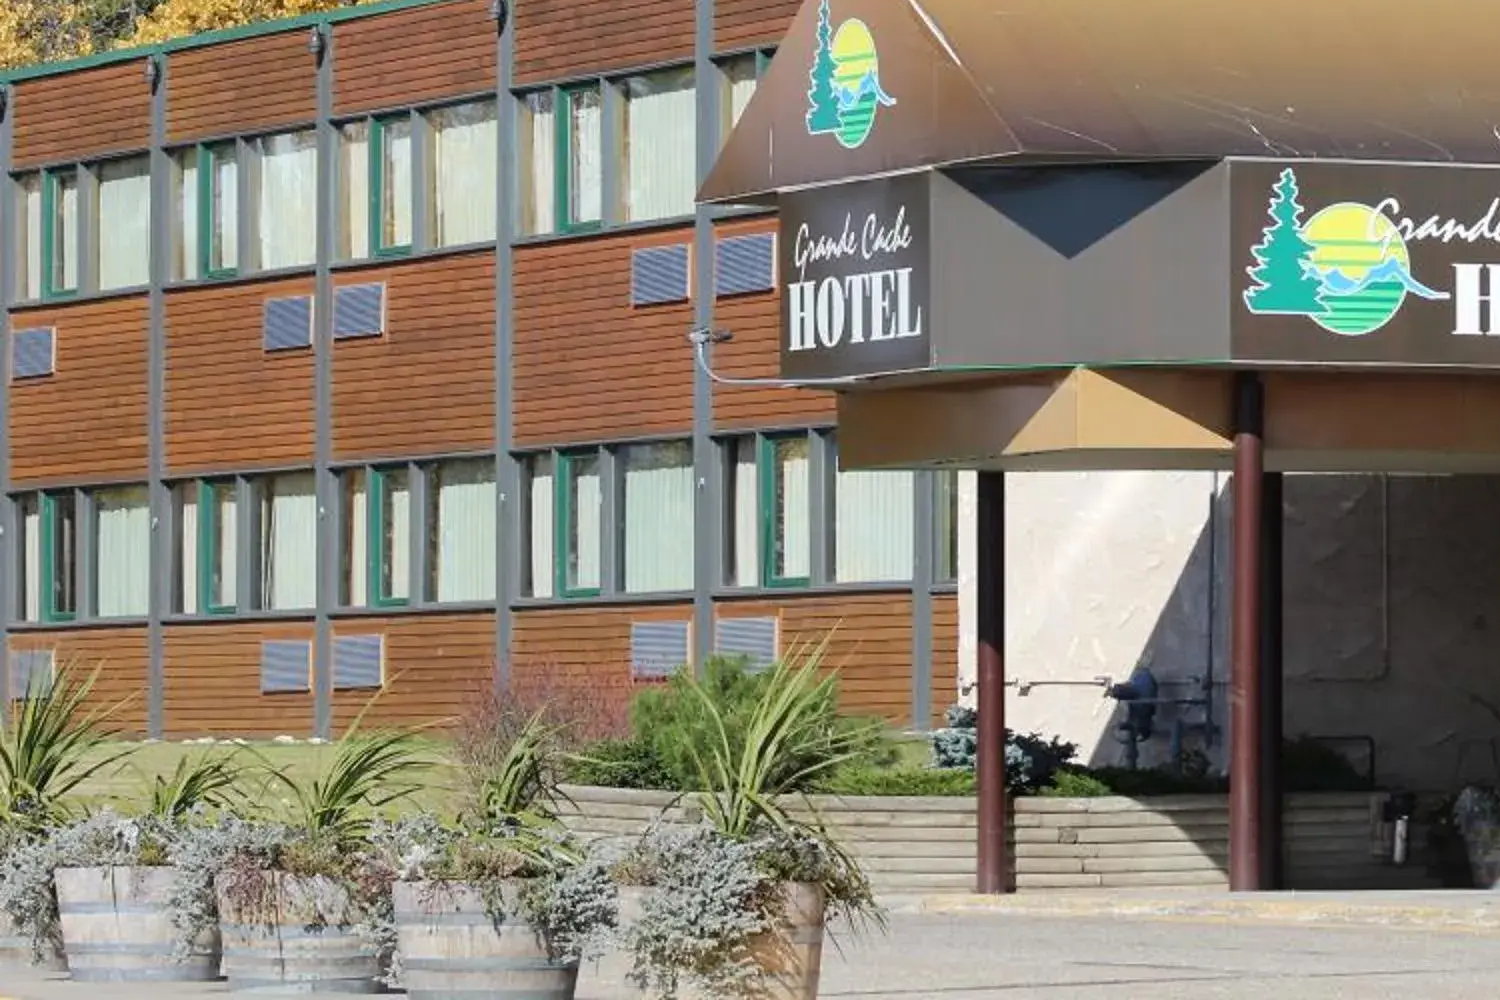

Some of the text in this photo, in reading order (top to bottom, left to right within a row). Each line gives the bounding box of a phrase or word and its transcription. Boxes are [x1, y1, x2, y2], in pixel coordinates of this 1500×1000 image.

[795, 205, 912, 281] Grande Cache
[788, 267, 922, 351] HOTEL
